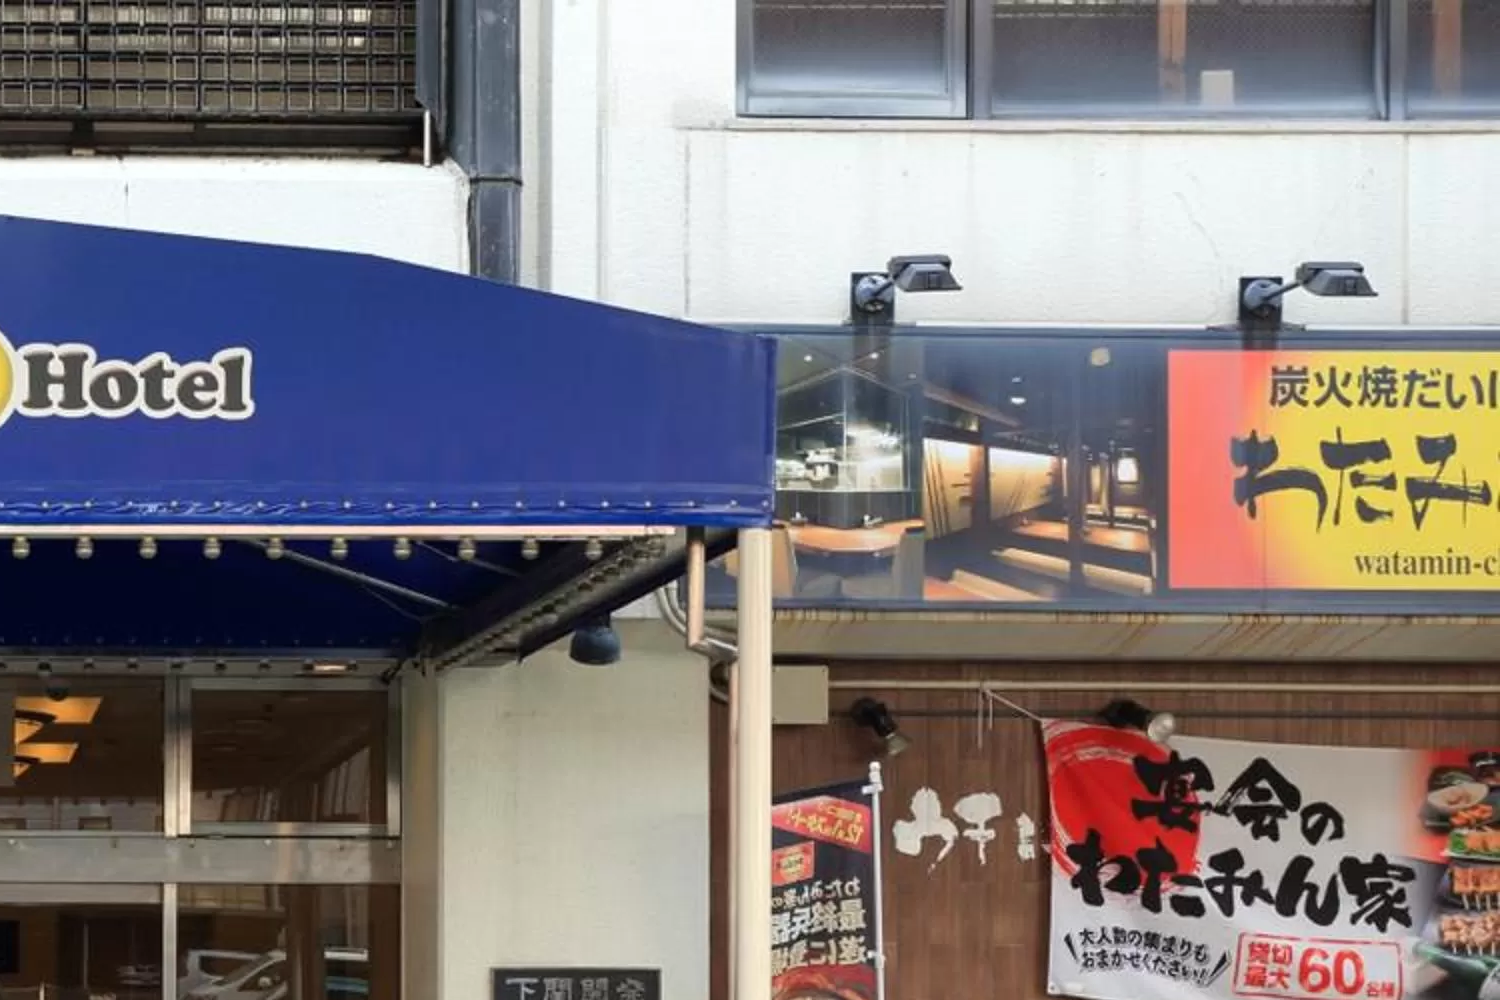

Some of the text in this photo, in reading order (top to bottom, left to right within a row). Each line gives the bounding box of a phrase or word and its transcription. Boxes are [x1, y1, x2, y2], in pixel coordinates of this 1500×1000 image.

[18, 348, 252, 415] Hotel
[1269, 365, 1500, 409] 炭火焼だい
[1230, 426, 1500, 533] わたみ
[1355, 548, 1500, 576] watamin-c
[1132, 750, 1344, 844] 宴会の
[1066, 829, 1415, 931] わたみん家
[1244, 966, 1290, 990] 最大
[1299, 948, 1365, 995] 60
